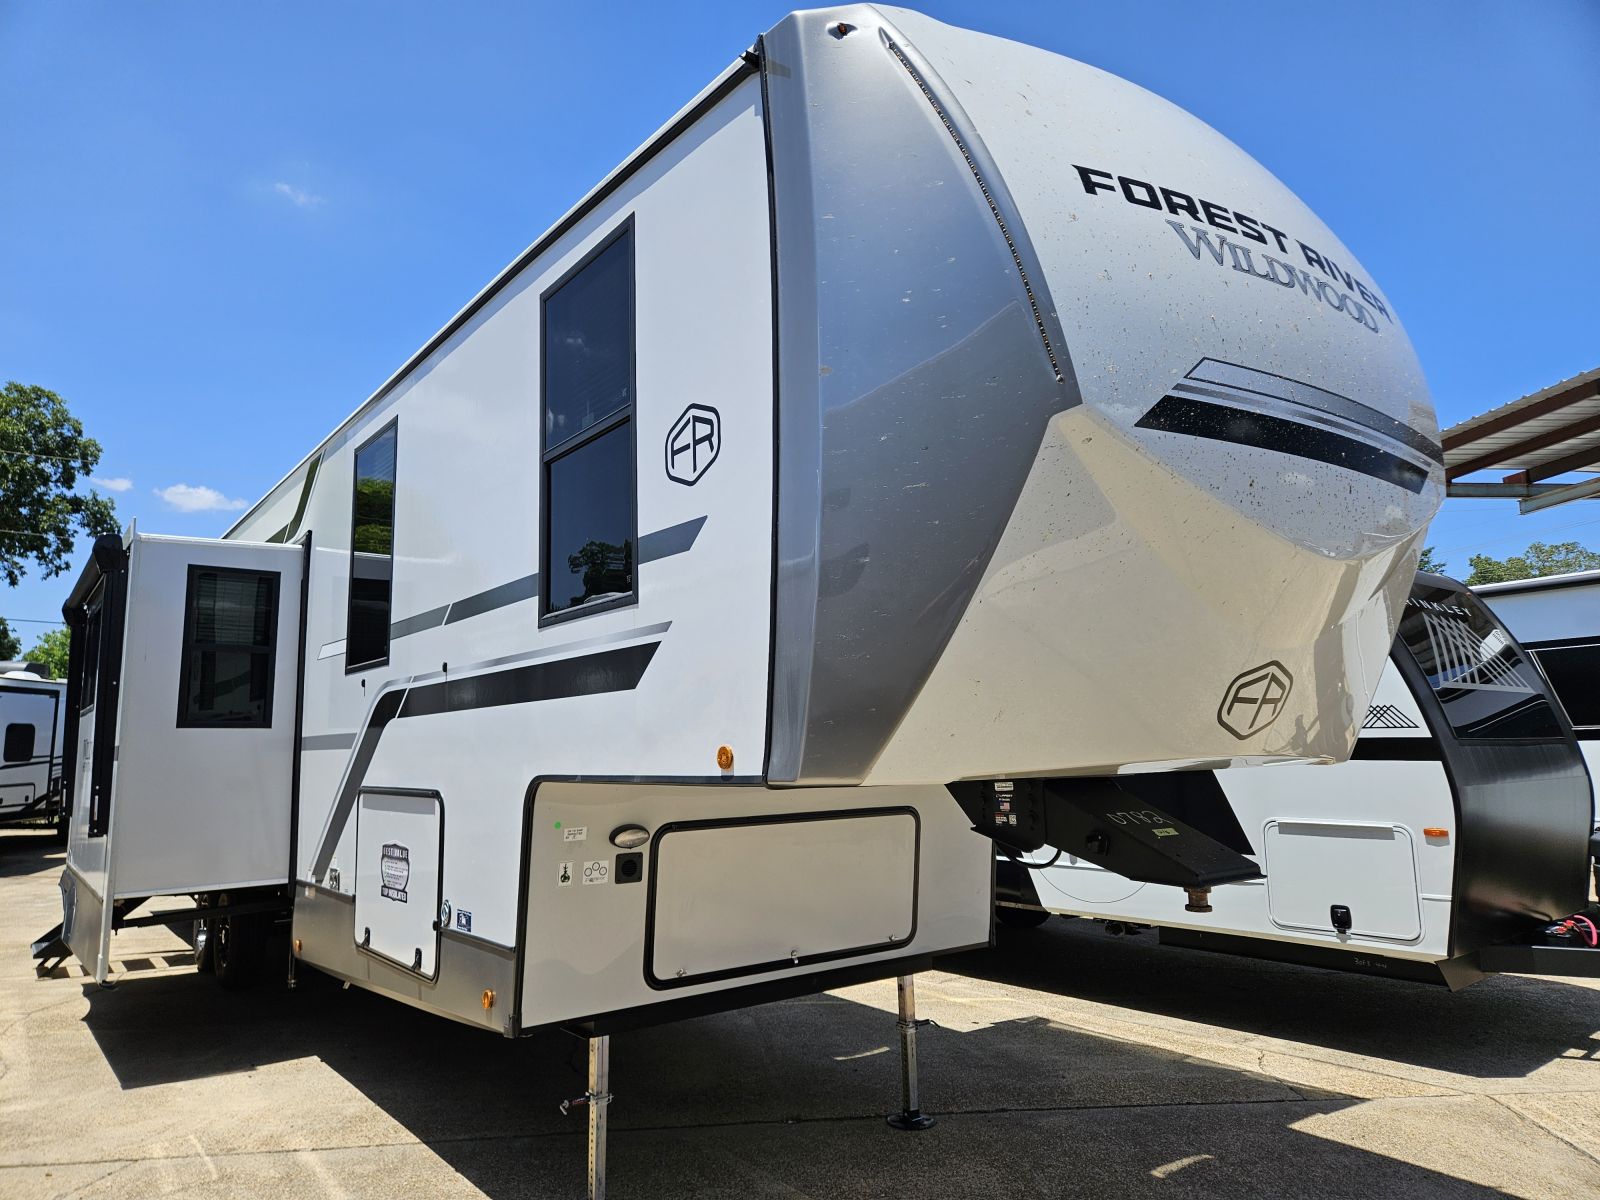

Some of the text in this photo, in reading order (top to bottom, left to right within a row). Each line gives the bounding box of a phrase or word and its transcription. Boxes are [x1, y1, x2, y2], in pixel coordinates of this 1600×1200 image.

[1072, 164, 1394, 324] FOREST RIVER
[1165, 219, 1379, 333] WILDWOOD
